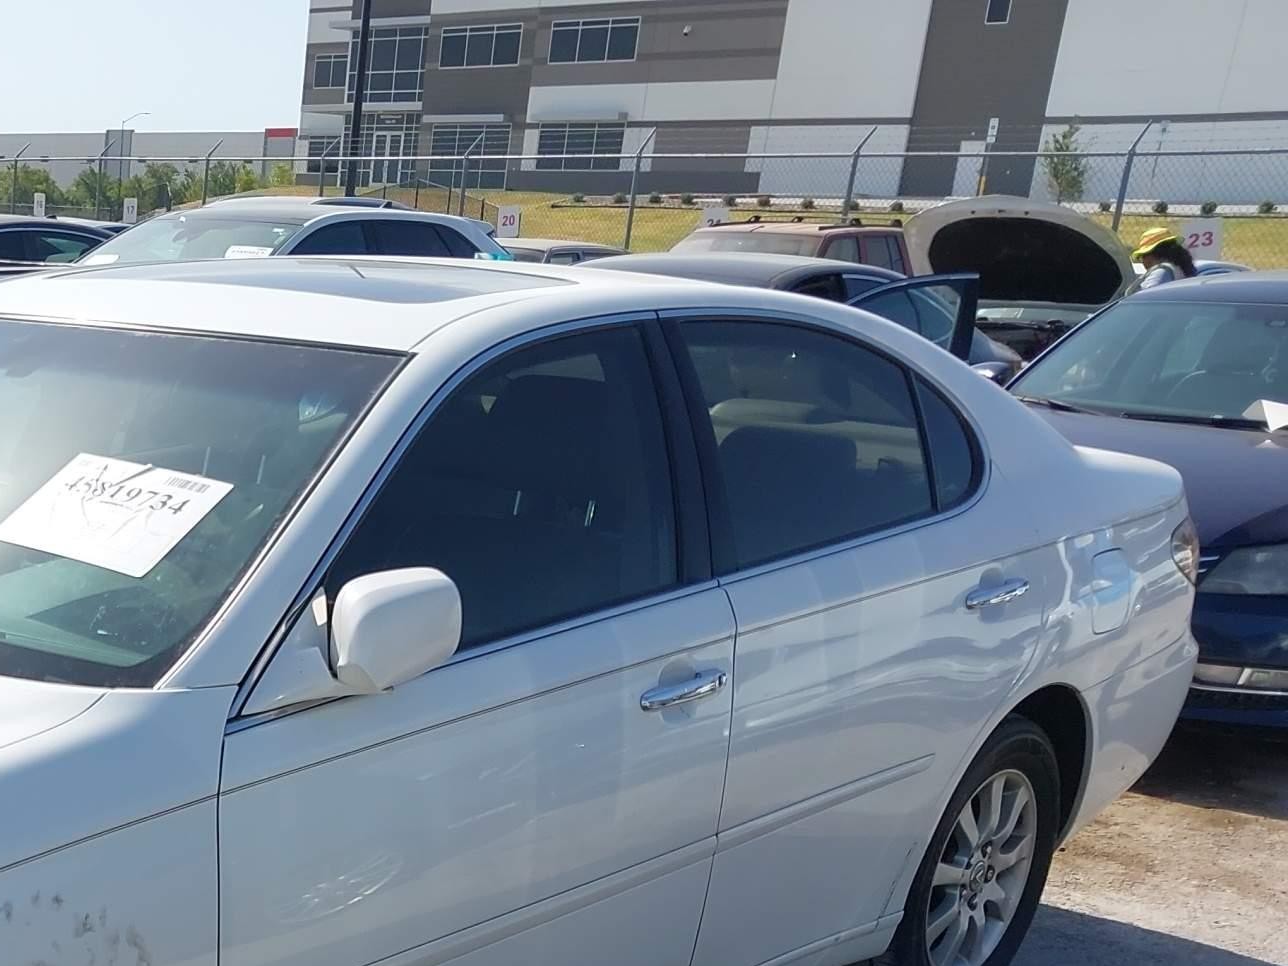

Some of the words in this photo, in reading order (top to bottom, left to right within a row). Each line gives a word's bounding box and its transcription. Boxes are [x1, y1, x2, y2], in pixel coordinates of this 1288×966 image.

[501, 214, 516, 227] 20
[1187, 231, 1214, 249] 23
[64, 475, 191, 515] 45819734
